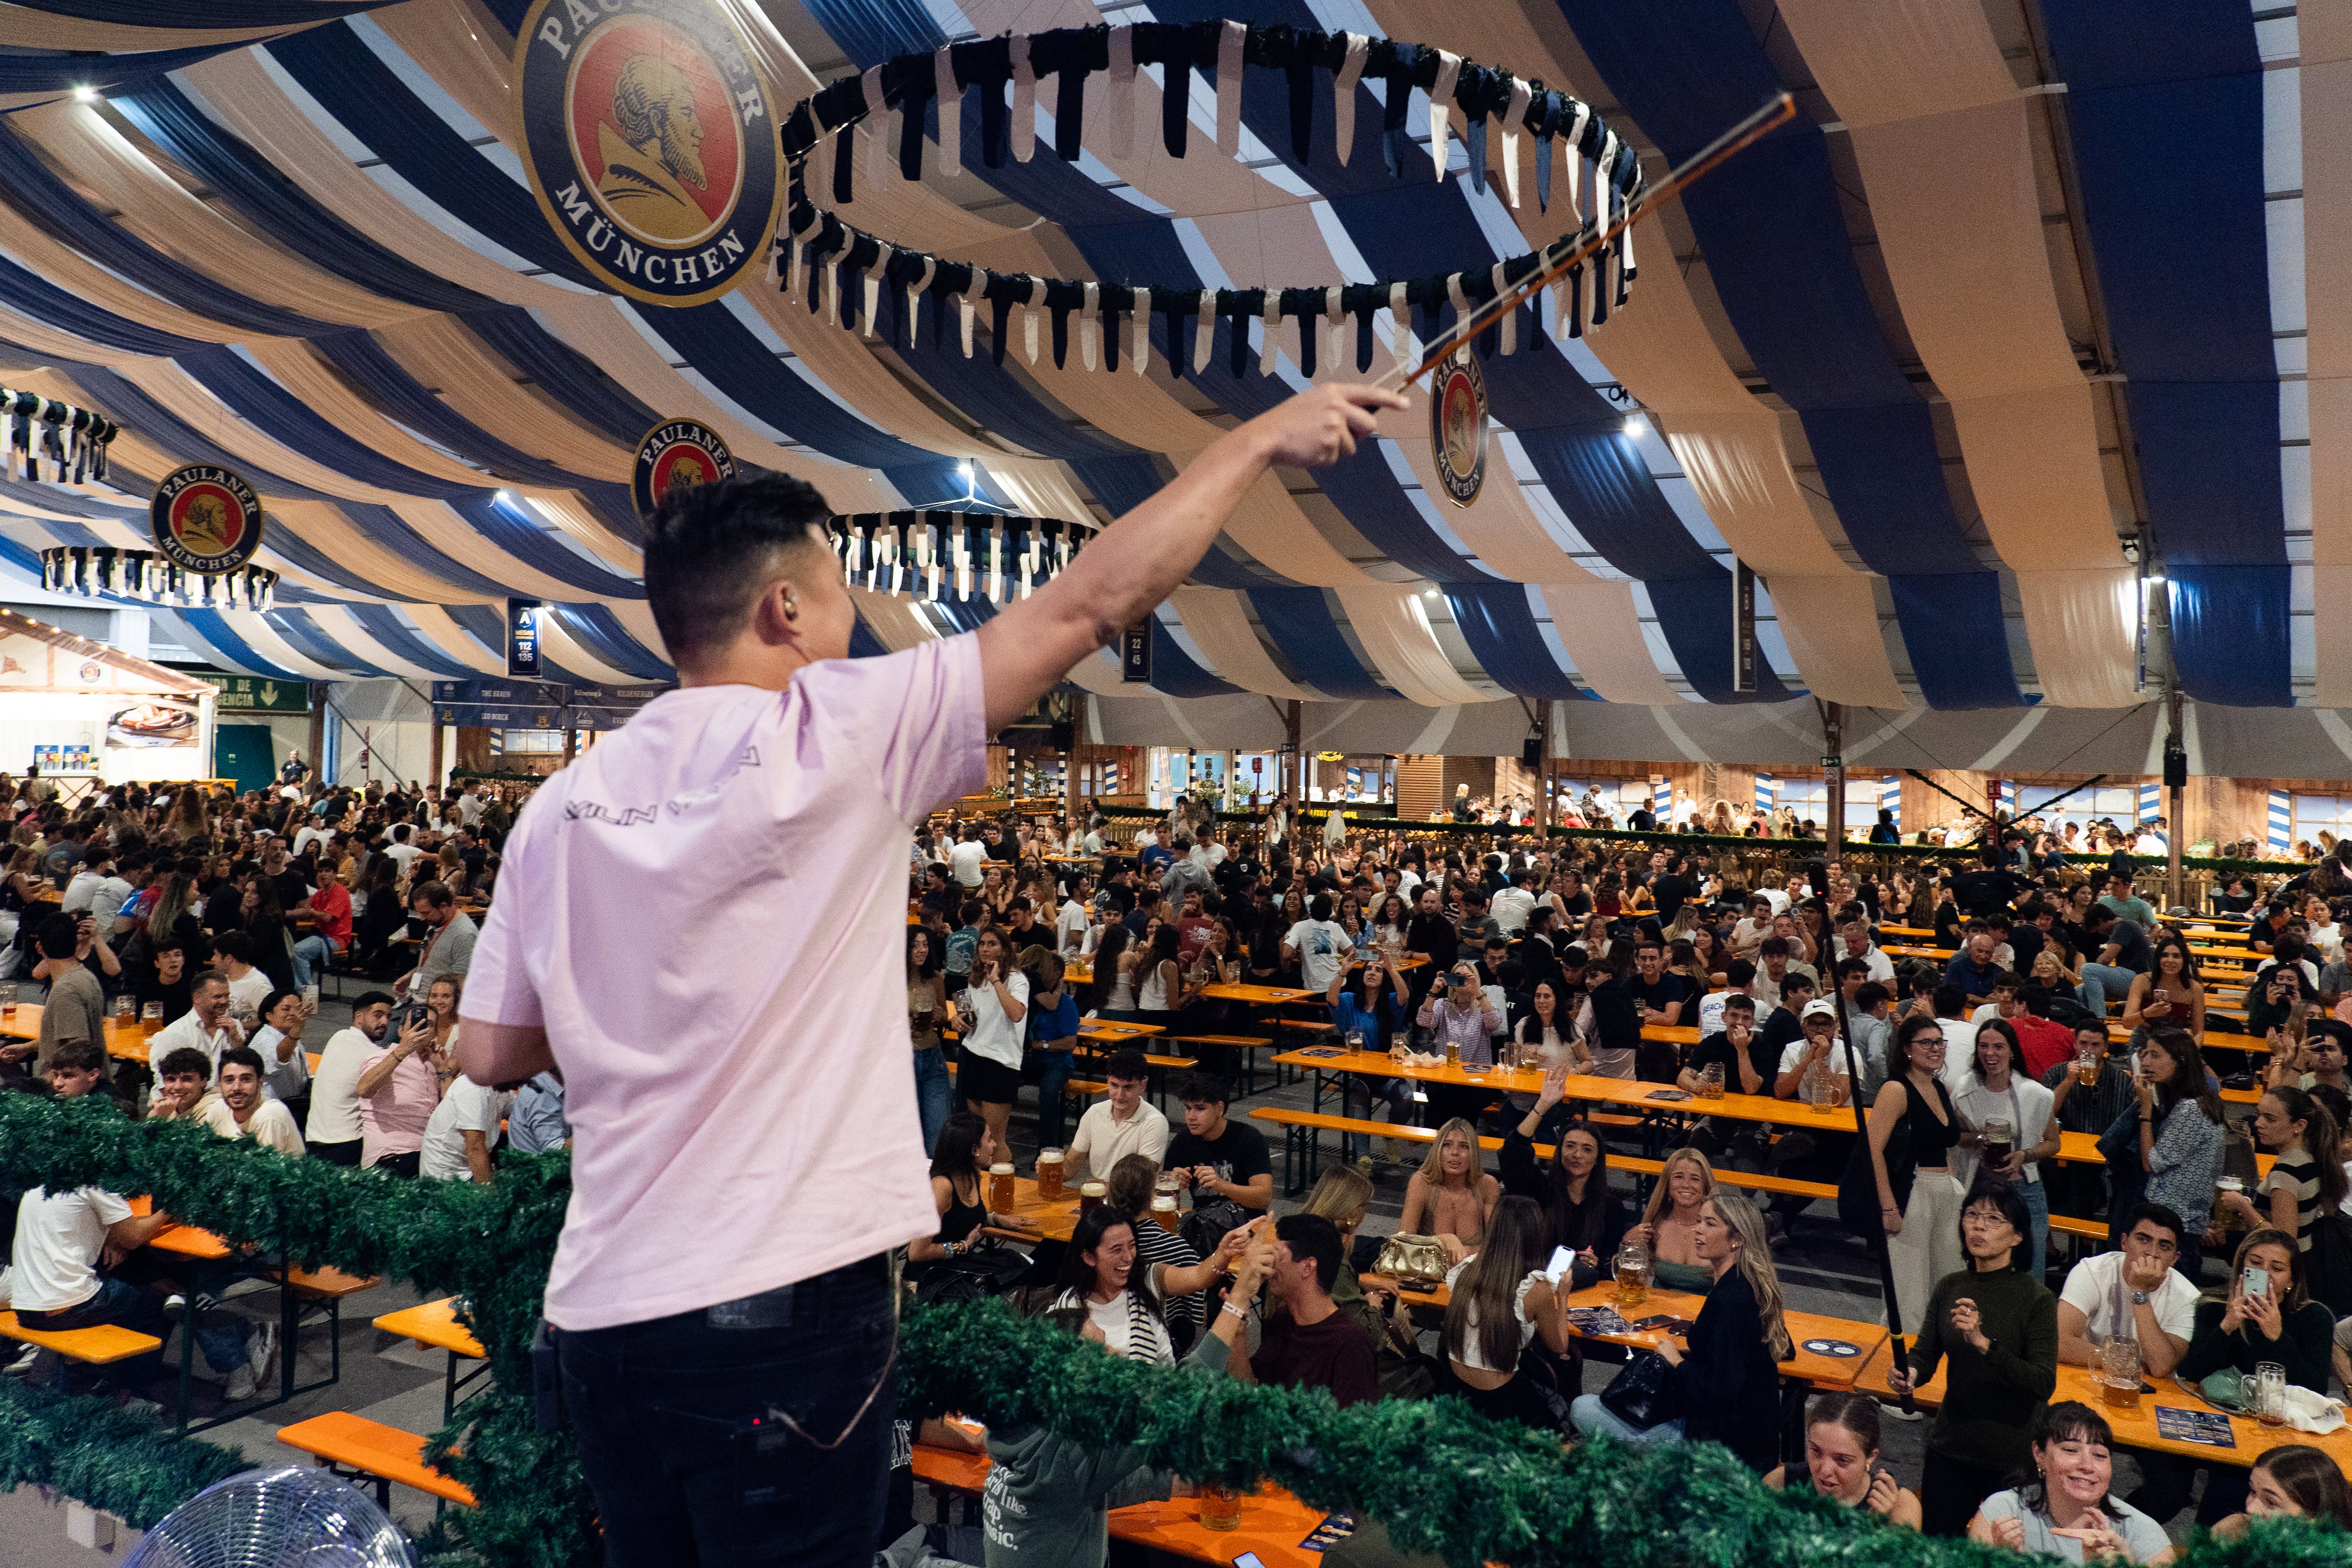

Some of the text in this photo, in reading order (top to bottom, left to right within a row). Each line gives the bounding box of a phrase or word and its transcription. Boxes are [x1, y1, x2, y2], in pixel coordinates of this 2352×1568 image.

[555, 181, 747, 285] MÜNCHEN
[641, 424, 733, 478] PAULANER
[162, 468, 257, 516] PAULANER
[162, 535, 243, 570] MÜNCHEN
[518, 642, 532, 651] 112
[1132, 638, 1141, 649] 22
[518, 653, 533, 661] 135
[1132, 654, 1141, 665] 45
[237, 679, 252, 692] DE
